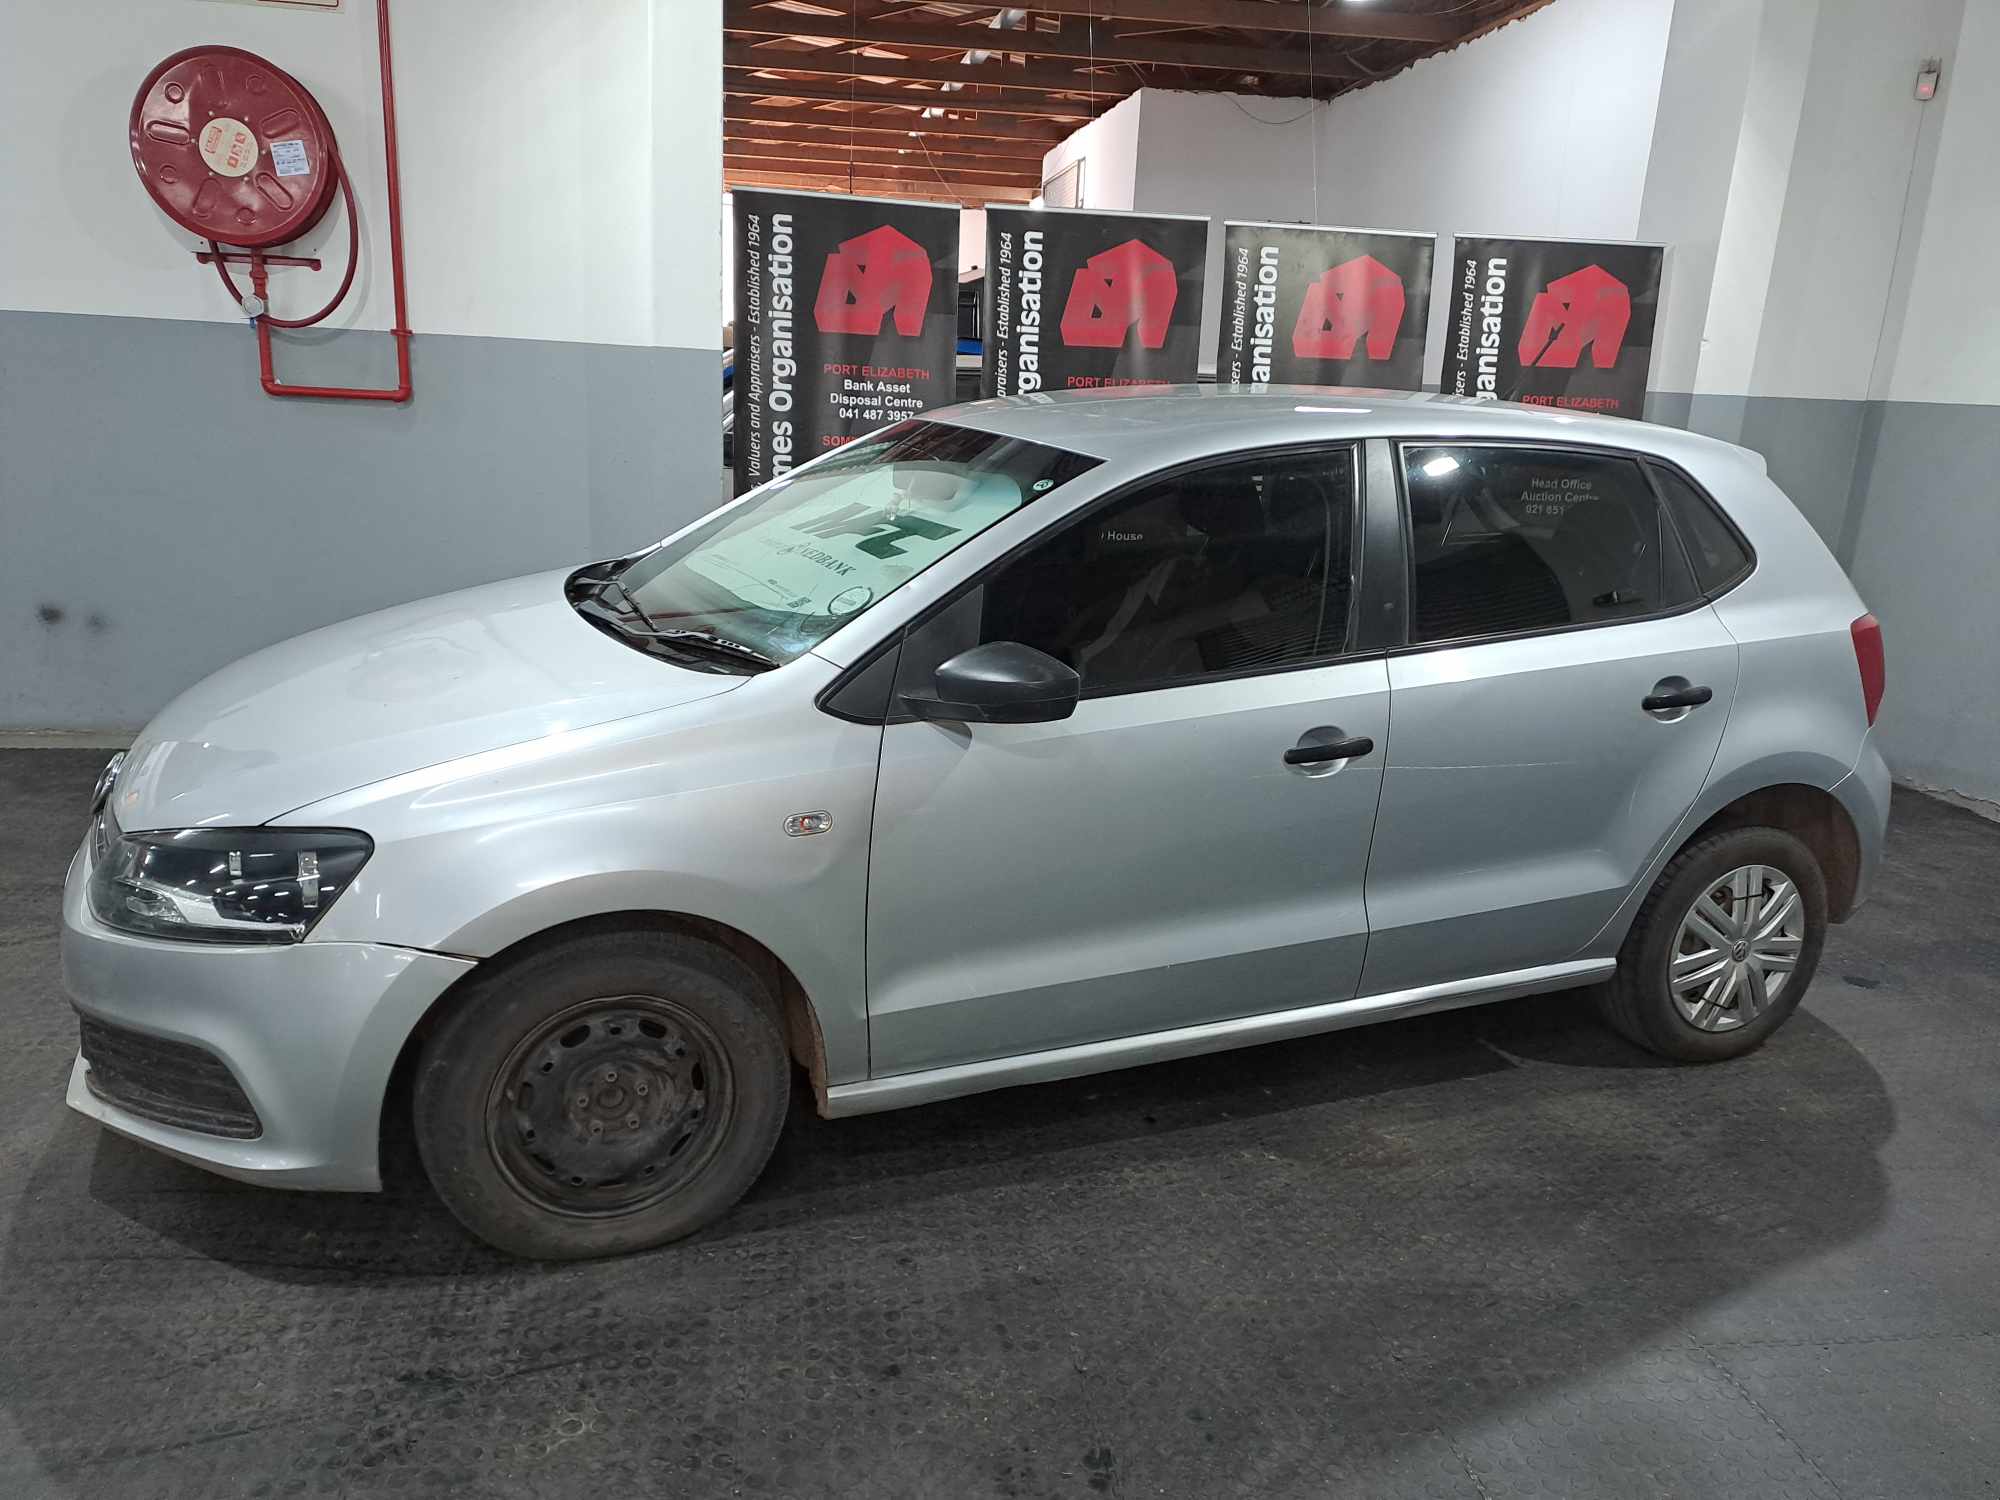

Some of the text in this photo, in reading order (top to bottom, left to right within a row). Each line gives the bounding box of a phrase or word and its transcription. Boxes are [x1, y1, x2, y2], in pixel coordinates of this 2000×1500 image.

[747, 214, 760, 248] 1964
[999, 232, 1013, 264] 1964
[1236, 248, 1249, 279] 1964
[747, 250, 760, 324] Established
[1464, 260, 1478, 290] 1964
[768, 213, 796, 412] Organisation
[996, 267, 1010, 339] Established
[1017, 230, 1044, 396] ganisation
[1231, 281, 1247, 351] Established
[1250, 246, 1279, 384] anisation
[1456, 292, 1474, 360] Established
[748, 334, 762, 401] Appraisers
[823, 364, 930, 380] PORT ELIZABETH
[994, 348, 1008, 398] praisers
[1067, 376, 1101, 388] PORT
[830, 392, 923, 408] Disposal Centre
[844, 379, 910, 394] Bank Asset
[1522, 395, 1618, 408] PORT ELIZABETH
[748, 403, 760, 428] and
[839, 408, 914, 421] 041 487 3957
[748, 432, 760, 476] Valuers
[1520, 491, 1562, 501] Auction
[1531, 478, 1592, 490] Head Office
